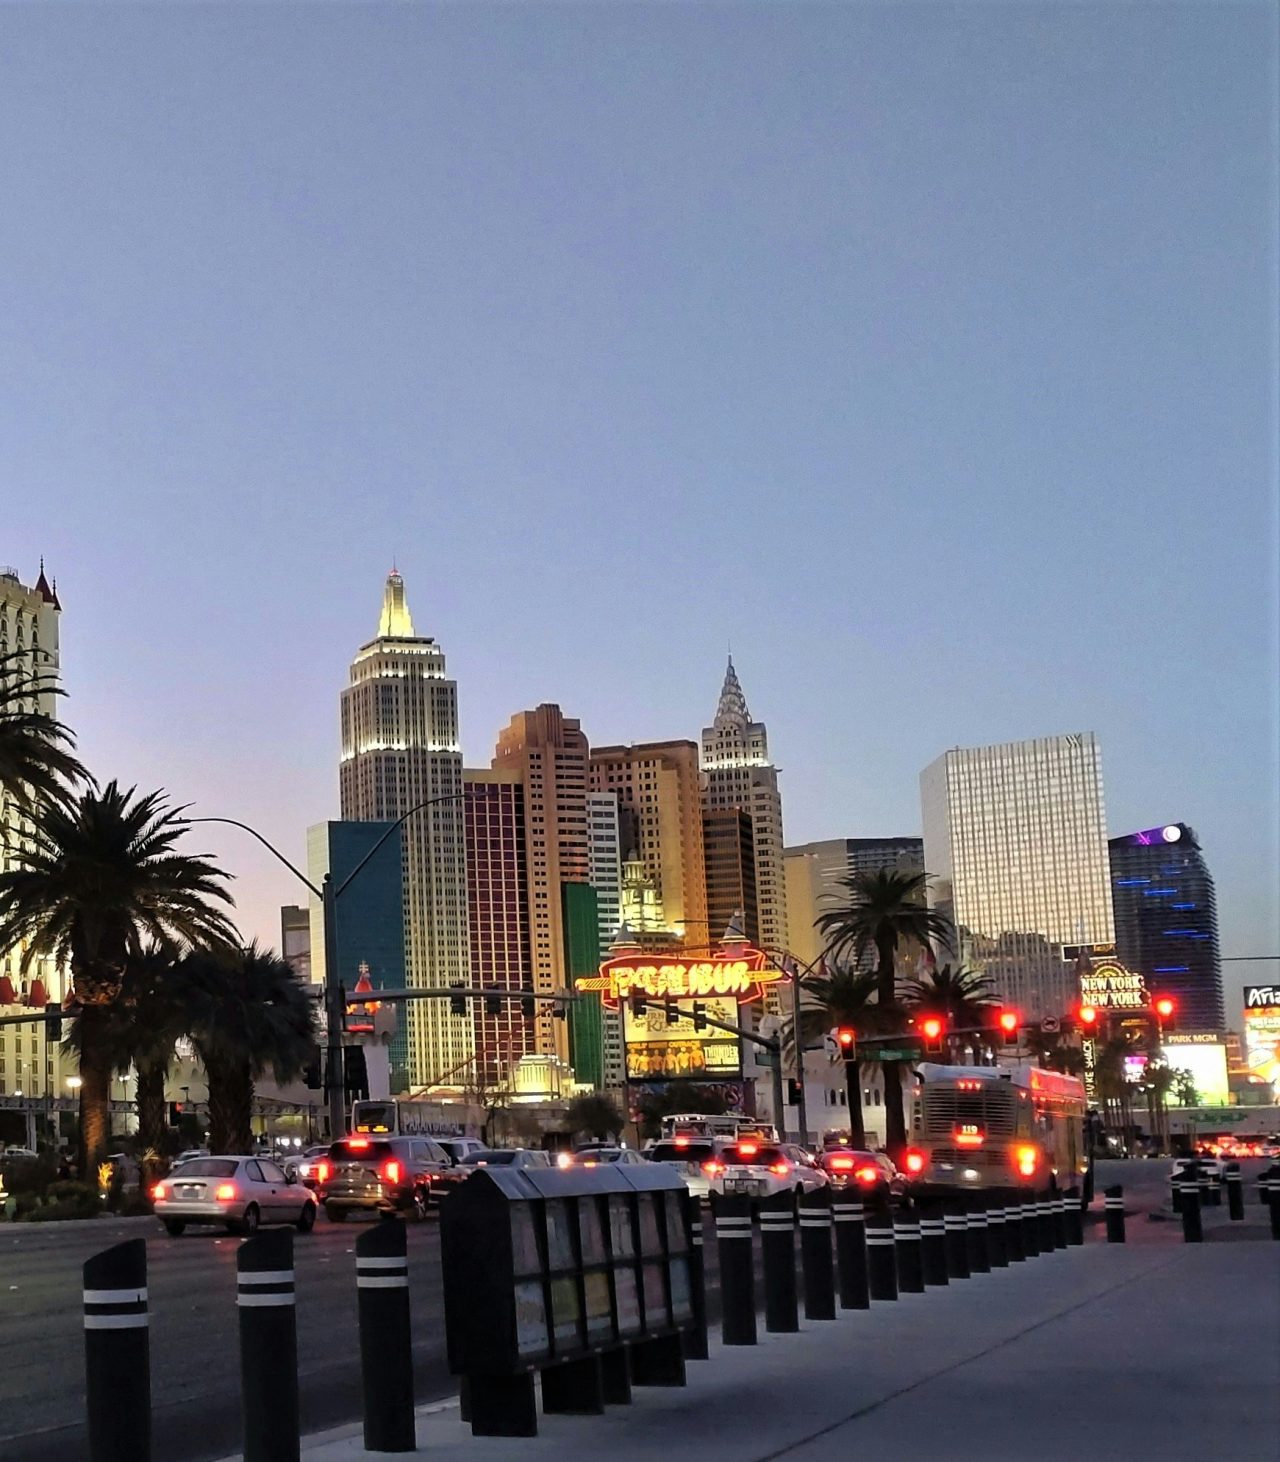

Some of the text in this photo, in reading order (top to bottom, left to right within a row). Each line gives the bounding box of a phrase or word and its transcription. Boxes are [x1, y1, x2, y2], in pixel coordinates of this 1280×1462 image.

[1080, 975, 1142, 991] NEW YORK
[1082, 991, 1143, 1006] NEW YORK
[1168, 1034, 1218, 1043] PARK MGM
[1082, 1040, 1094, 1069] SHACK
